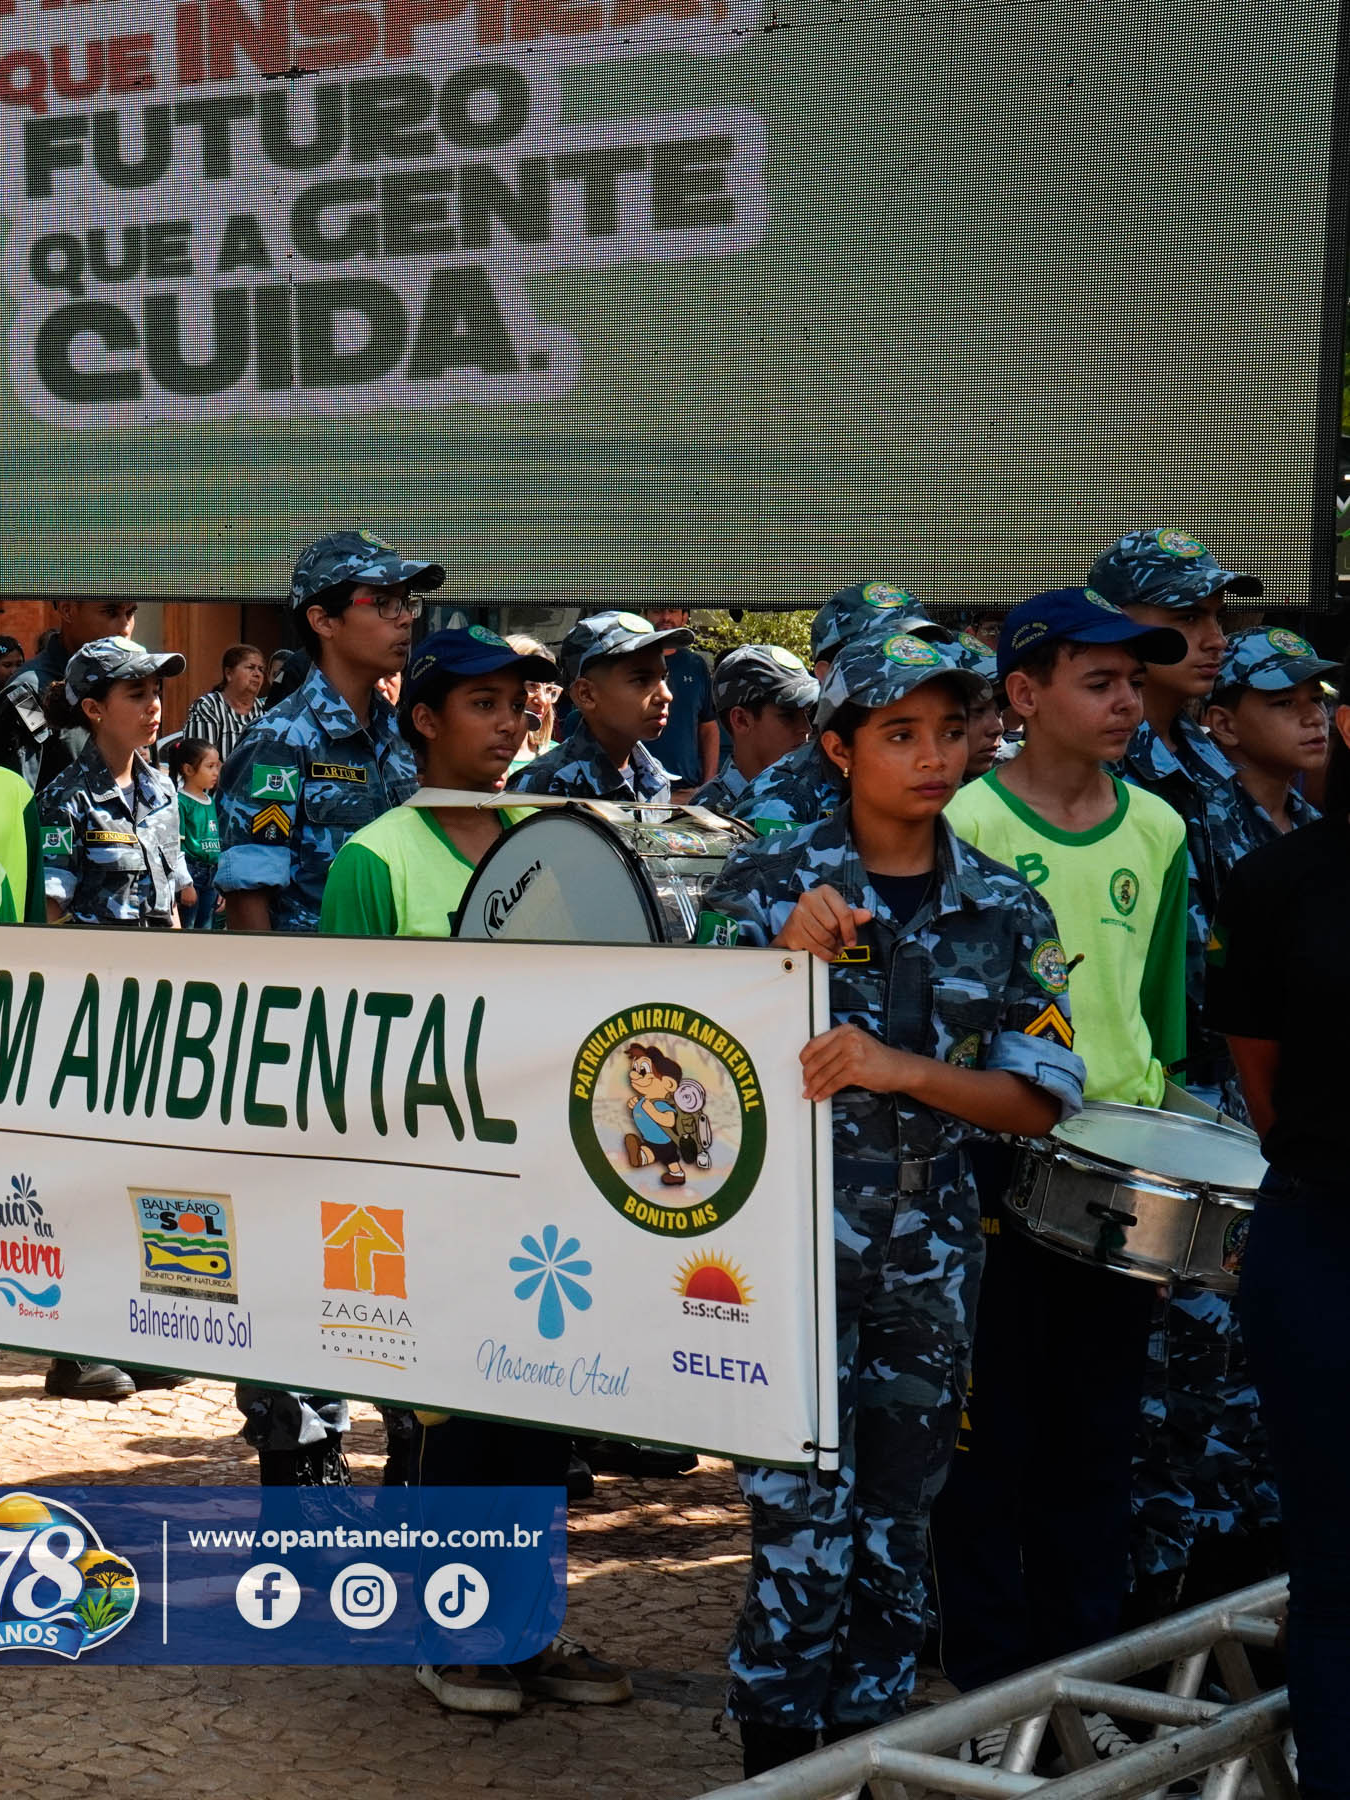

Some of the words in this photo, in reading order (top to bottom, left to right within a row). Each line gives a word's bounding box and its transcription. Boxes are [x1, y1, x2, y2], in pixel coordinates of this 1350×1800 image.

[24, 64, 529, 199] FUTURO
[29, 221, 193, 297] QUE
[219, 213, 272, 273] A
[291, 134, 735, 262] GENTE
[36, 265, 550, 401] CUIDA.
[323, 767, 357, 780] ARTUR
[49, 972, 518, 1145] AMBIENTAL
[575, 1017, 629, 1100] PATRULHA
[631, 1008, 686, 1031] MIRIM
[687, 1018, 761, 1113] AMBIENTAL
[142, 1198, 220, 1216] BALNEÁRIO
[145, 1211, 159, 1220] do
[160, 1210, 223, 1236] SOL
[623, 1195, 688, 1230] BONITO
[691, 1203, 719, 1228] MS
[34, 1217, 54, 1238] da
[145, 1271, 175, 1281] BONITO
[194, 1278, 232, 1289] NATUREZA
[130, 1299, 200, 1342] Balneário
[204, 1312, 224, 1345] do
[227, 1312, 252, 1349] Sol
[321, 1300, 413, 1327] ZAGAIA
[477, 1339, 566, 1388] Nascente
[569, 1351, 631, 1399] Azul
[672, 1350, 769, 1387] SELETA
